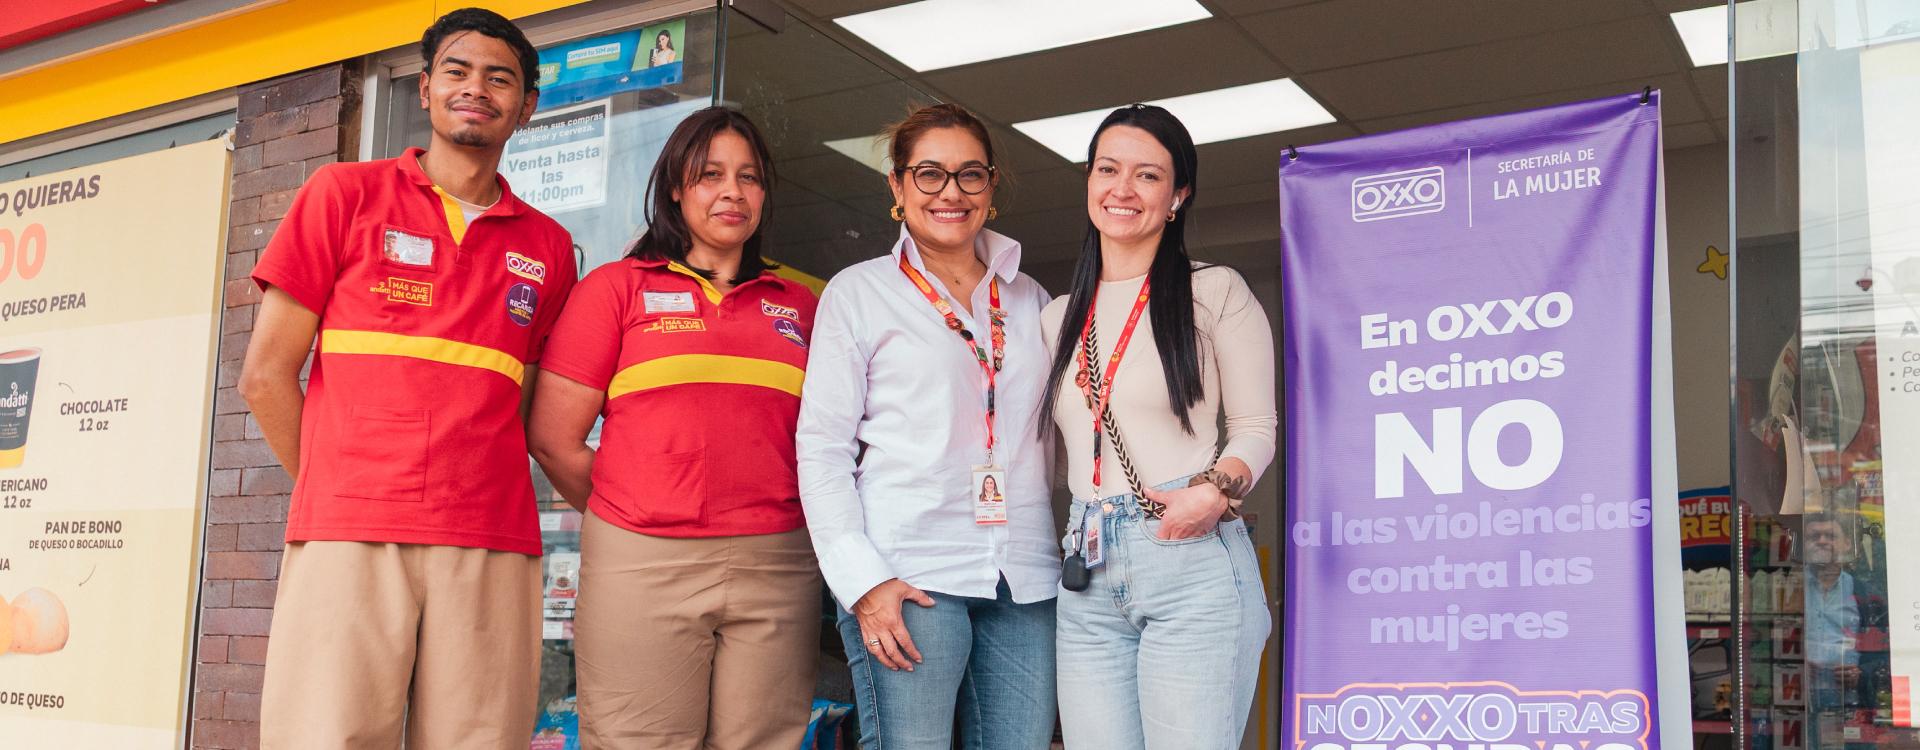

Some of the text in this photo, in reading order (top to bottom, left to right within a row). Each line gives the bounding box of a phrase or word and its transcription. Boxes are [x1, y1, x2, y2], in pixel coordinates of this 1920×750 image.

[512, 112, 604, 137] Adelante sus compras
[518, 137, 529, 145] de
[531, 133, 550, 143] licor
[551, 132, 557, 140] y
[508, 145, 600, 173] Venta hasta
[1498, 148, 1595, 174] SECRETARÍA DE
[541, 171, 564, 184] las
[1493, 167, 1602, 201] LA MUJER
[13, 174, 101, 217] QUIERAS
[520, 184, 584, 204] 11:00pm
[1357, 177, 1440, 212] OXXO
[509, 257, 543, 278] OXXO
[392, 281, 409, 291] MÁS
[392, 290, 405, 299] UN
[2, 292, 87, 322] QUESO PERA
[1360, 291, 1574, 350] En OXXO
[1368, 350, 1565, 396] decimos
[0, 391, 28, 408] ndatti
[60, 398, 128, 416] CHOCOLATE
[79, 418, 109, 432] 12 oz
[1375, 399, 1564, 499] NO
[0, 477, 48, 492] ERICANO
[4, 495, 32, 509] 12 oz
[45, 520, 122, 534] PAN DE BONO
[1292, 493, 1651, 547] a las violencias
[29, 539, 123, 551] DE QUESO O BOCADILLO
[1347, 550, 1594, 594] contra las
[1370, 604, 1569, 651] mujeres
[0, 691, 64, 710] O DE QUESO
[1307, 694, 1640, 742] NOXXOTRAS
